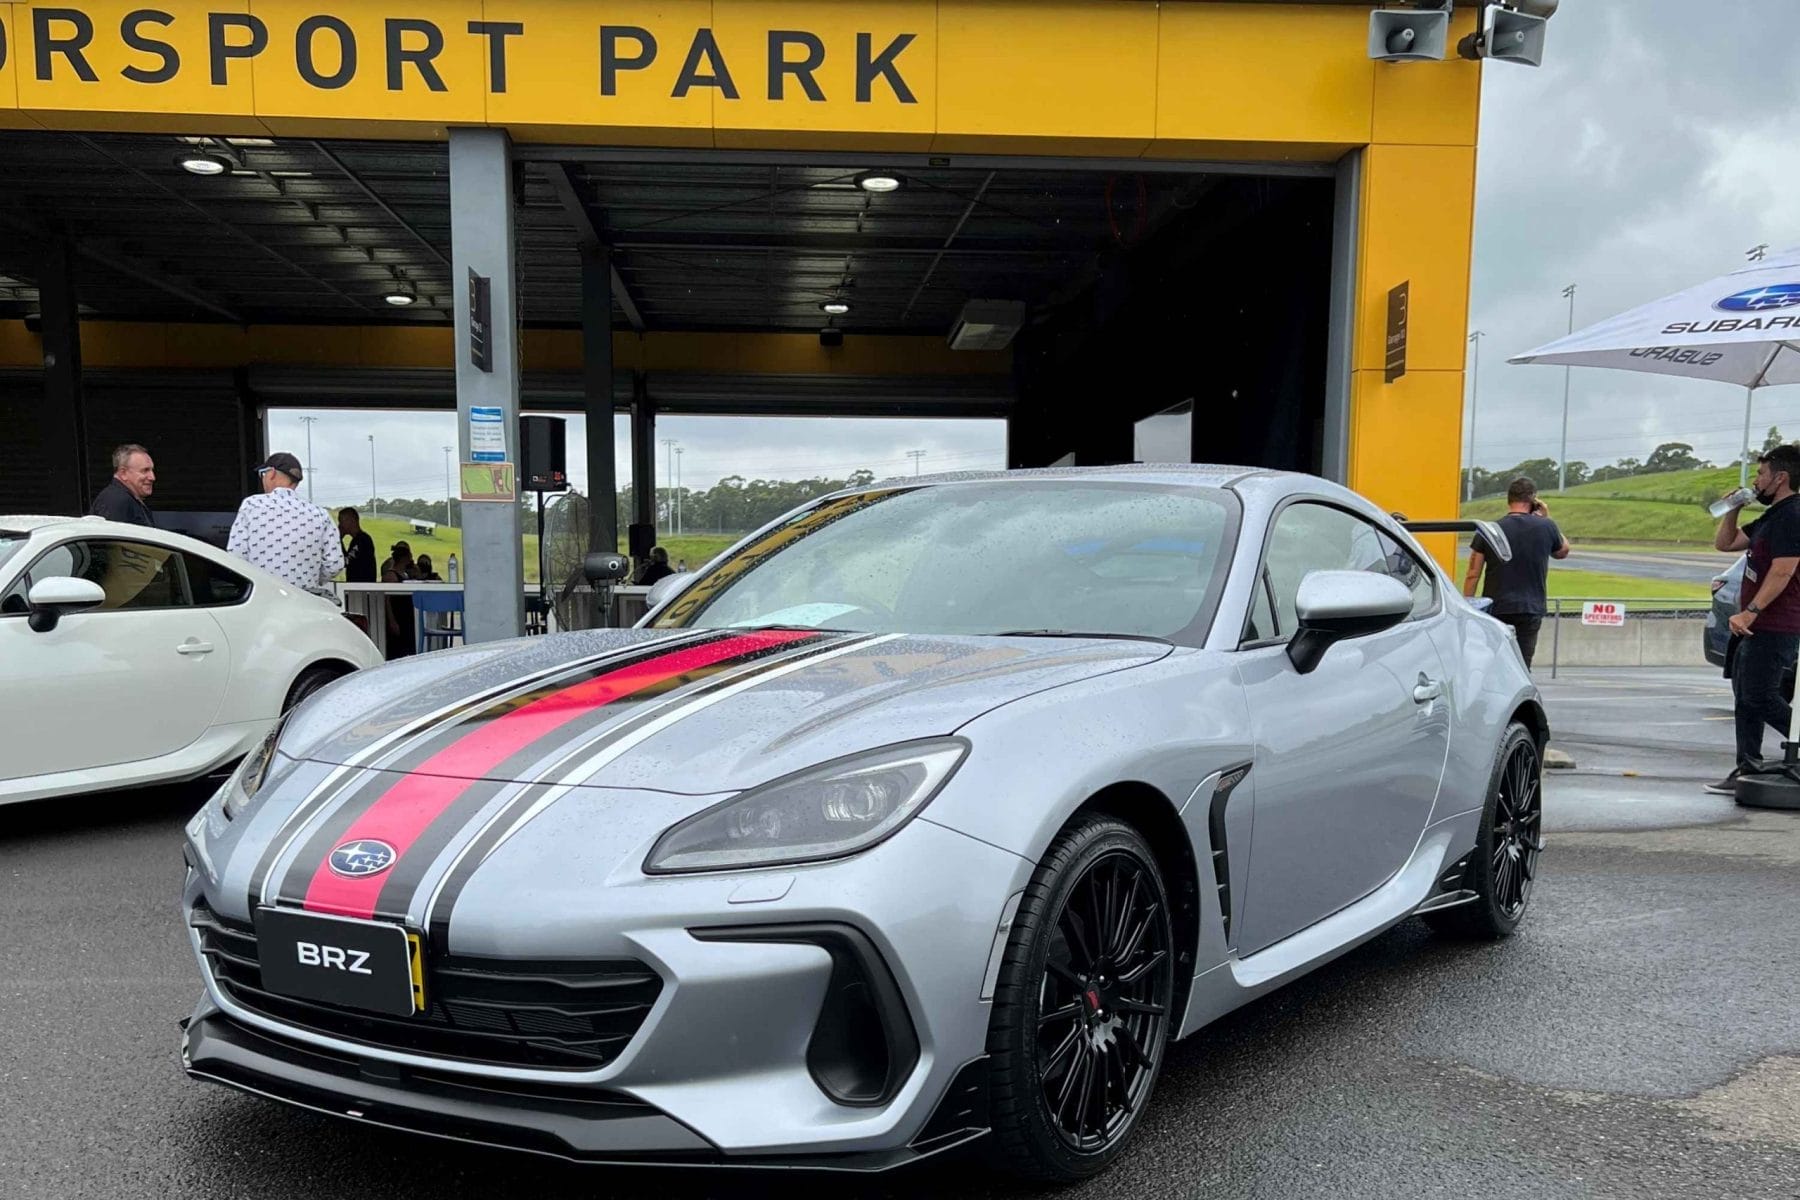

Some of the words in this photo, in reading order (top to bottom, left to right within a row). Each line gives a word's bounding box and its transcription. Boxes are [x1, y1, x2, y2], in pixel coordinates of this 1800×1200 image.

[0, 7, 524, 93] RSPORT
[599, 25, 919, 104] PARK
[1398, 293, 1407, 325] 3
[1661, 316, 1800, 334] SUBAR
[1593, 604, 1615, 613] NO
[296, 941, 372, 975] BRZ
